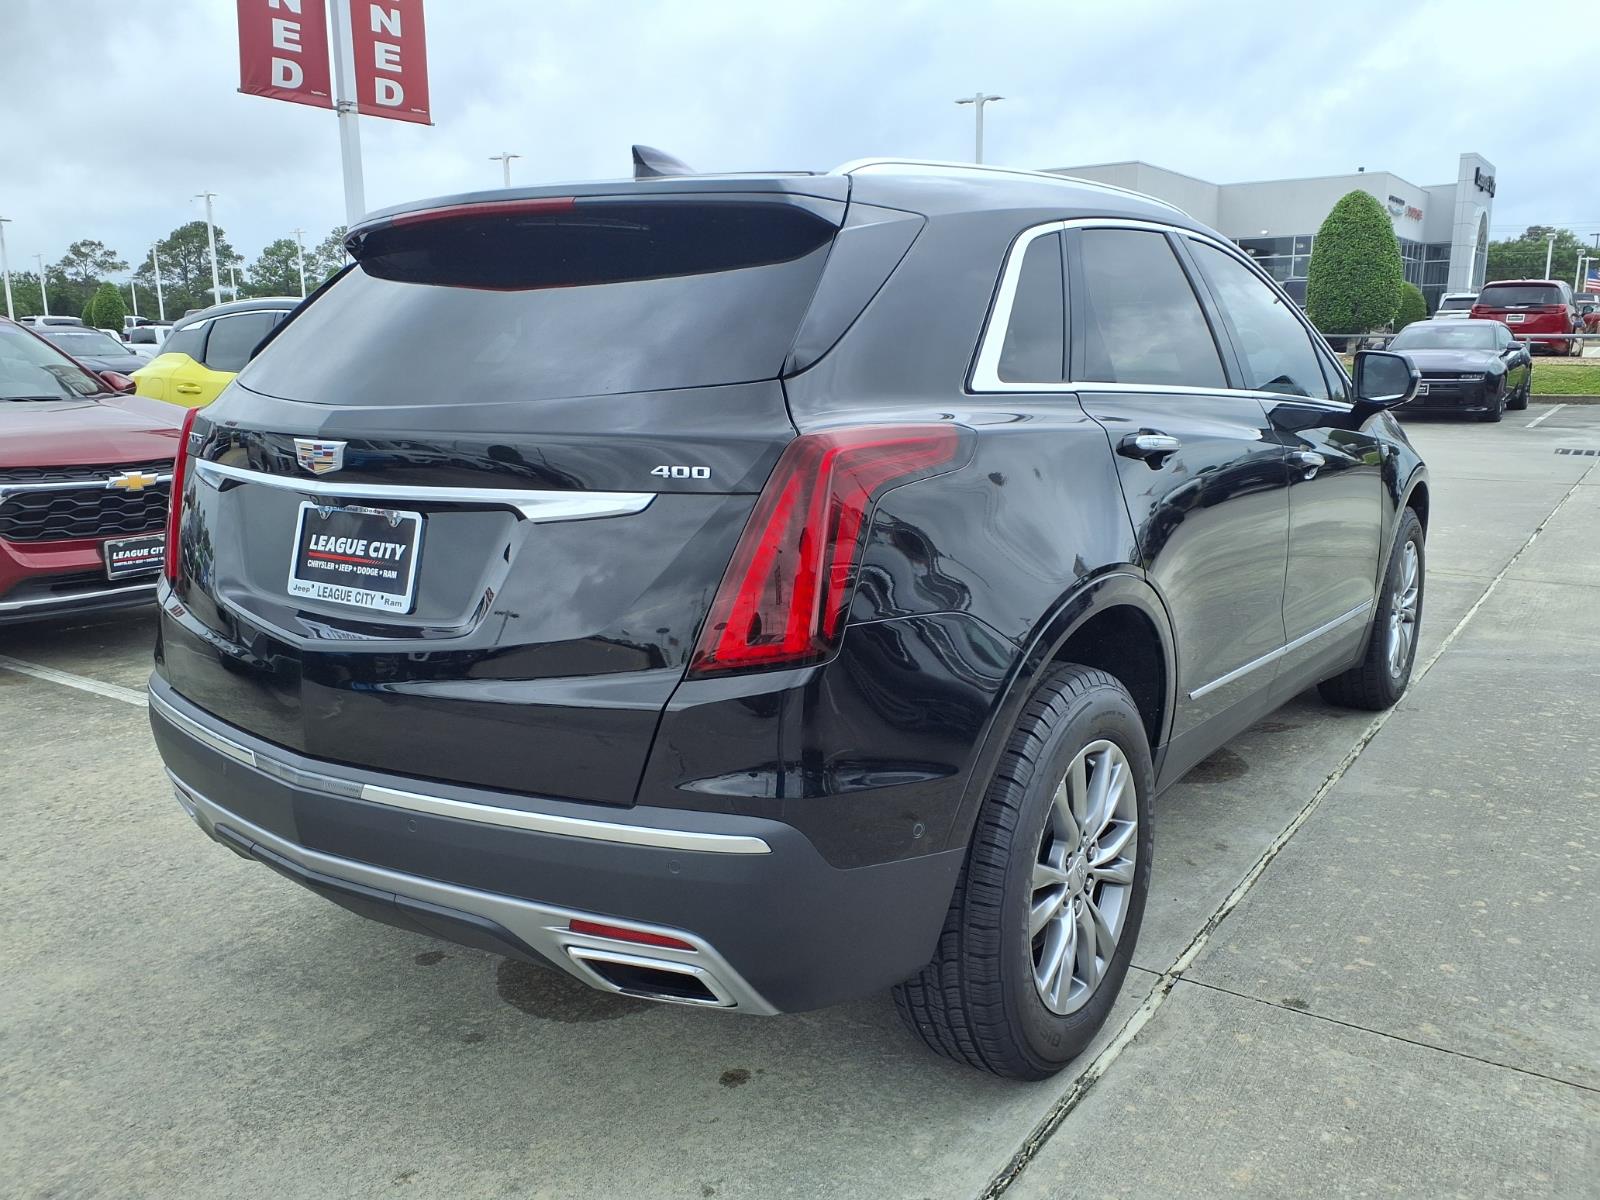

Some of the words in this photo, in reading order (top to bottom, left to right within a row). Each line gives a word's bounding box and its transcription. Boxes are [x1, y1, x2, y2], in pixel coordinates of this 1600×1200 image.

[370, 0, 404, 107] NED
[650, 465, 711, 479] 400
[112, 548, 149, 560] LEAGUE
[150, 546, 165, 555] CIT
[309, 534, 368, 556] LEAGUE
[368, 541, 407, 561] CITY
[307, 559, 335, 571] CHRYSLER
[338, 563, 353, 573] JEEP
[357, 566, 379, 577] DODGE
[382, 569, 398, 579] RAM
[293, 583, 311, 593] Jeep
[316, 585, 353, 602] LEAGUE
[354, 591, 376, 606] CITY
[384, 598, 403, 608] Ram
